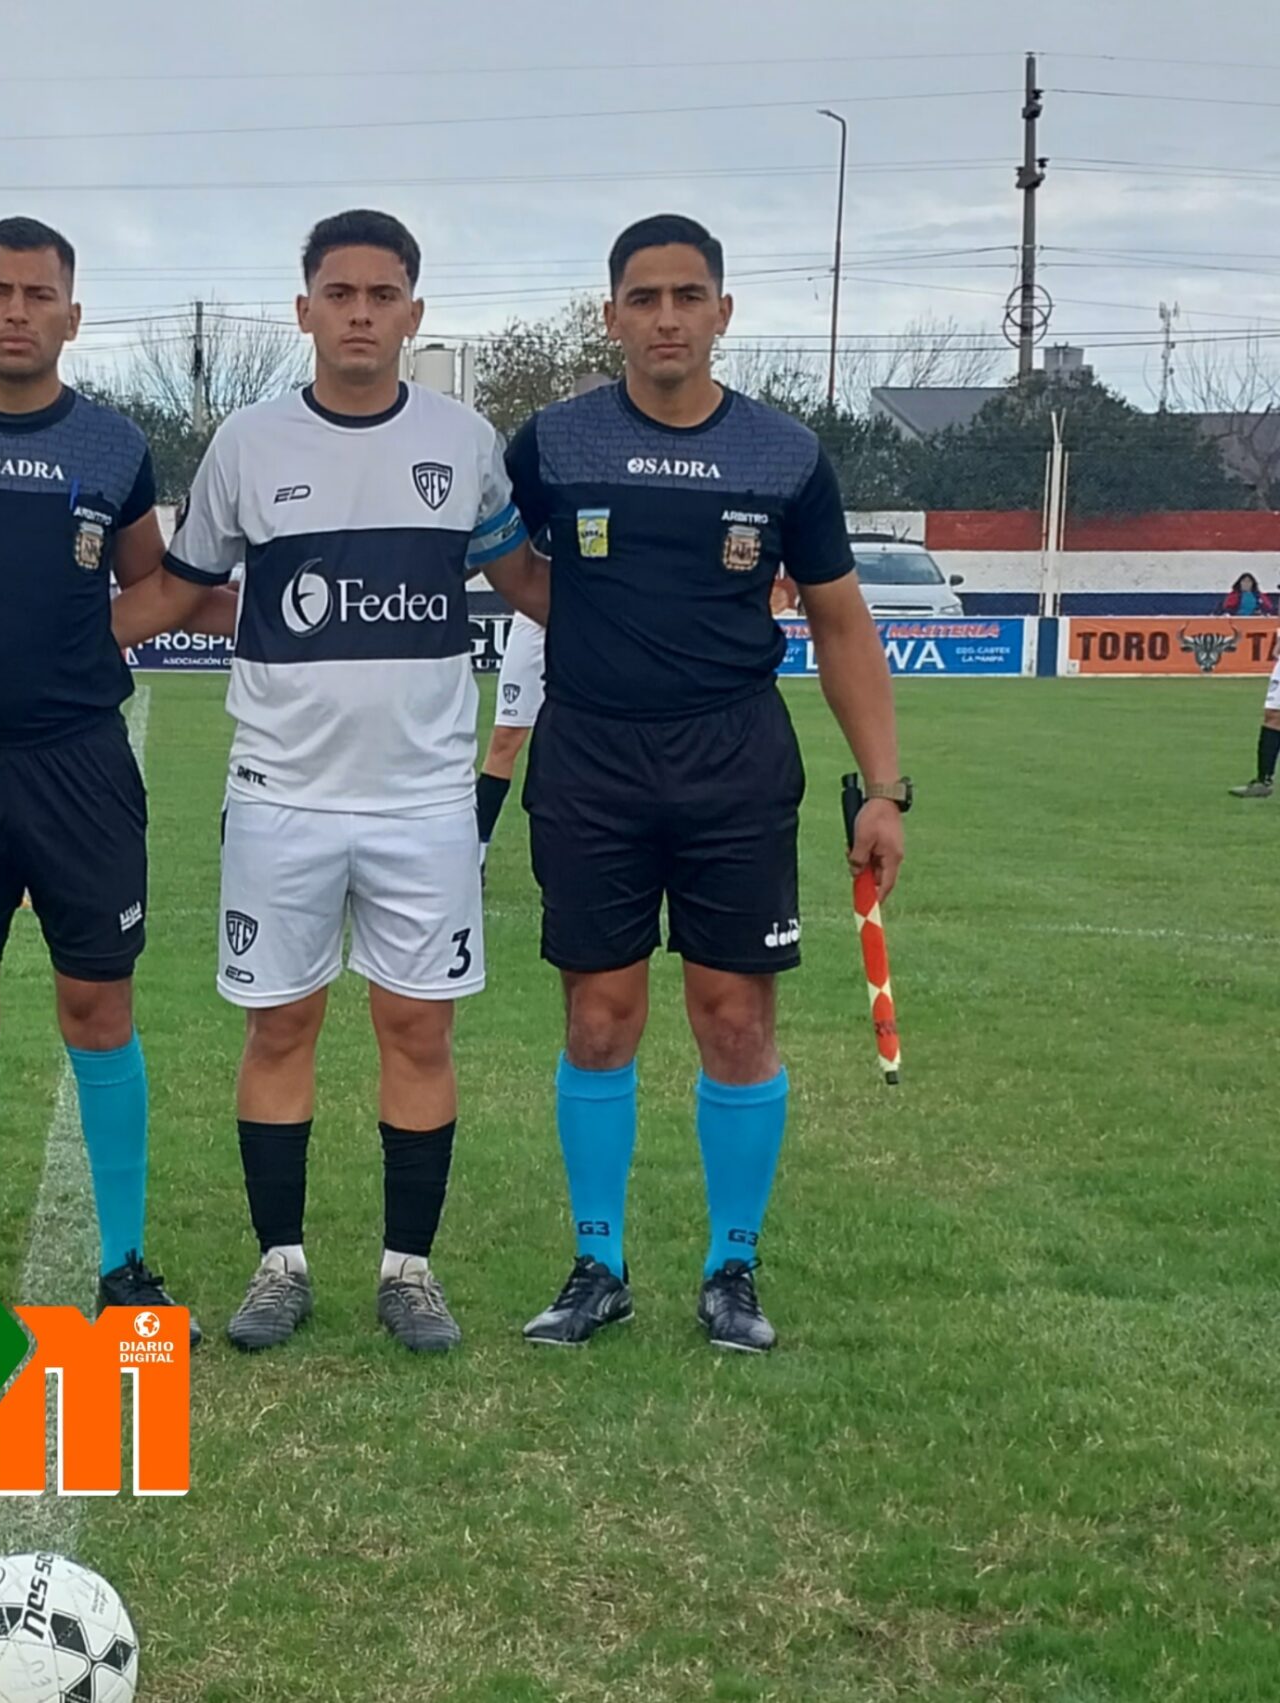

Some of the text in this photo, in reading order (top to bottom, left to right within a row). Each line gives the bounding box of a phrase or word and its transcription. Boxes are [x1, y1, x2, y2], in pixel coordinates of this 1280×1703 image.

[644, 458, 721, 479] SADRA
[722, 510, 769, 524] ARBITRO
[336, 579, 448, 622] Fedea
[1077, 632, 1170, 661] TORO
[447, 927, 471, 979] 3
[578, 1221, 610, 1237] G3
[727, 1228, 759, 1246] G3
